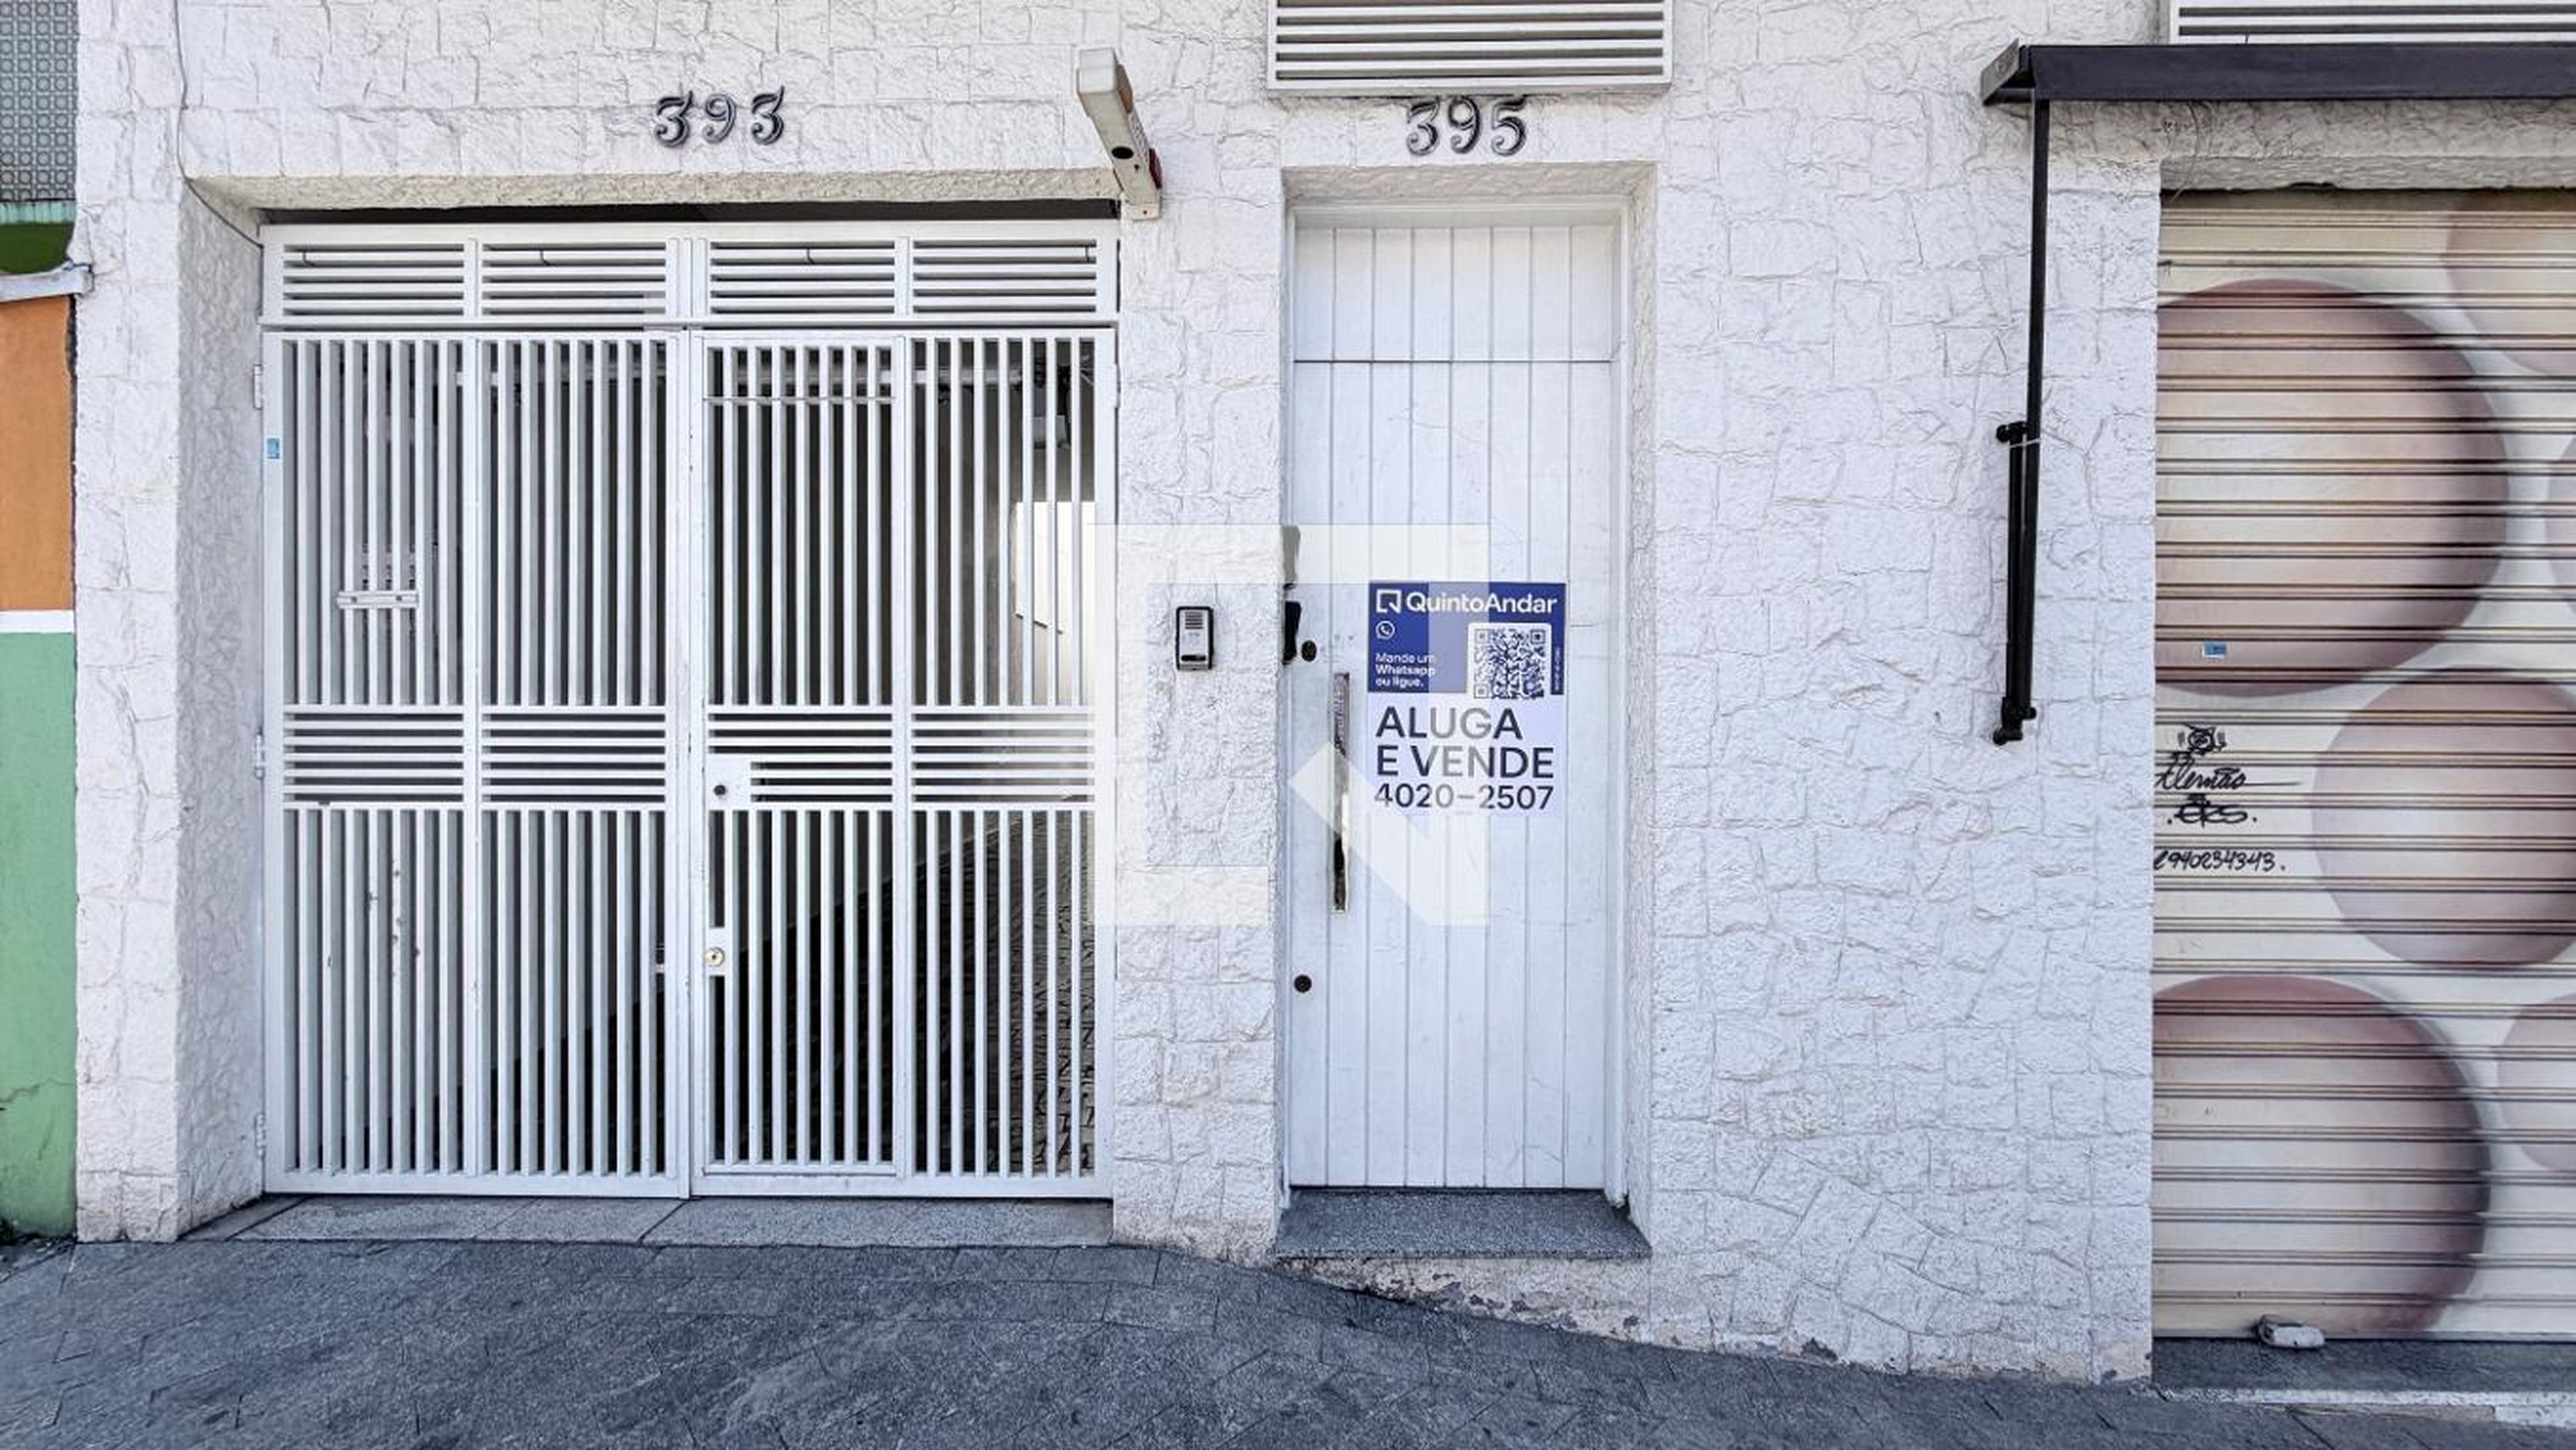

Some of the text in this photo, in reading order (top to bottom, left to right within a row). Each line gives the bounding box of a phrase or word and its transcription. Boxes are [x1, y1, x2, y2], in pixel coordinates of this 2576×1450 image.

[654, 85, 784, 148] 393
[1406, 95, 1527, 156] 395
[1406, 592, 1558, 614] QuintoAndar
[1375, 653, 1436, 663] Mande um
[1375, 664, 1436, 677] Whatsapp
[1375, 676, 1424, 688] ou ligue.
[1375, 706, 1523, 739] ALUGA
[1377, 744, 1554, 779] E VENDE
[1375, 782, 1554, 810] 4020-2507
